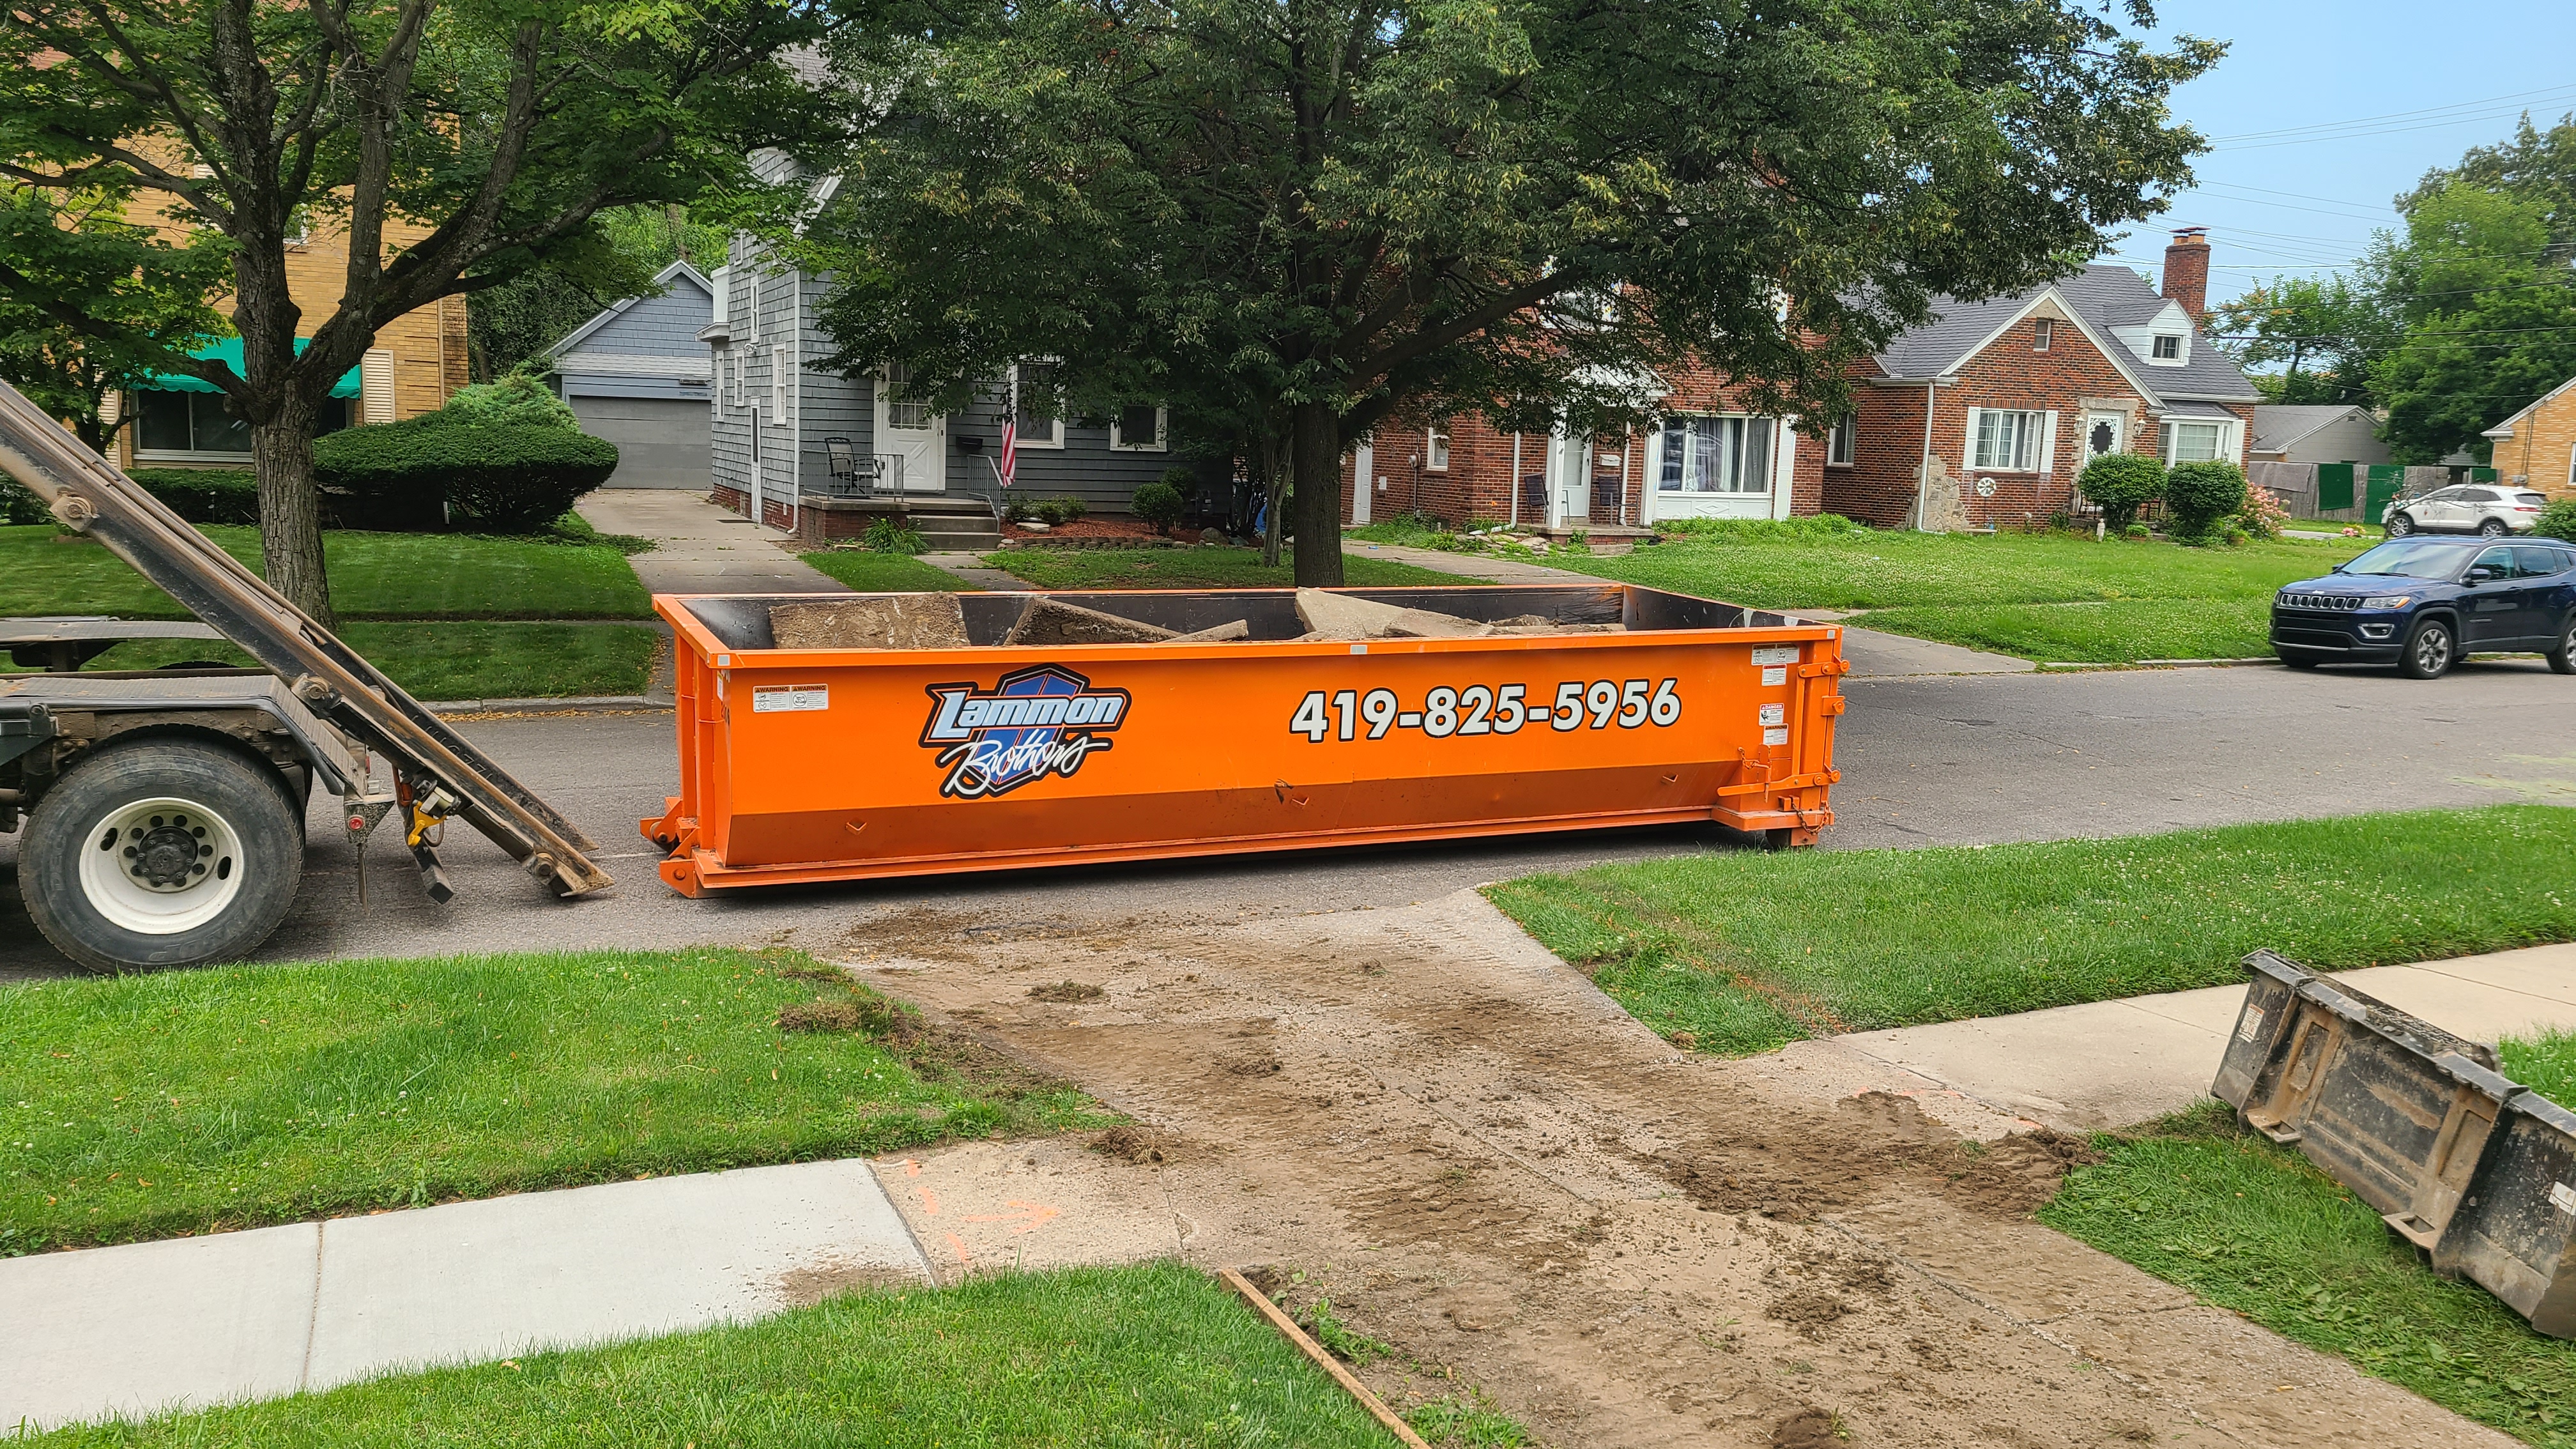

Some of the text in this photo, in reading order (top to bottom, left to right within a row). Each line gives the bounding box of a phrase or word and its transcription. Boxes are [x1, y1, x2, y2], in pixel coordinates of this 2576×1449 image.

[928, 689, 1125, 740] Lammon
[1289, 677, 1683, 743] 419-825-5956
[940, 728, 1109, 796] Brothers
